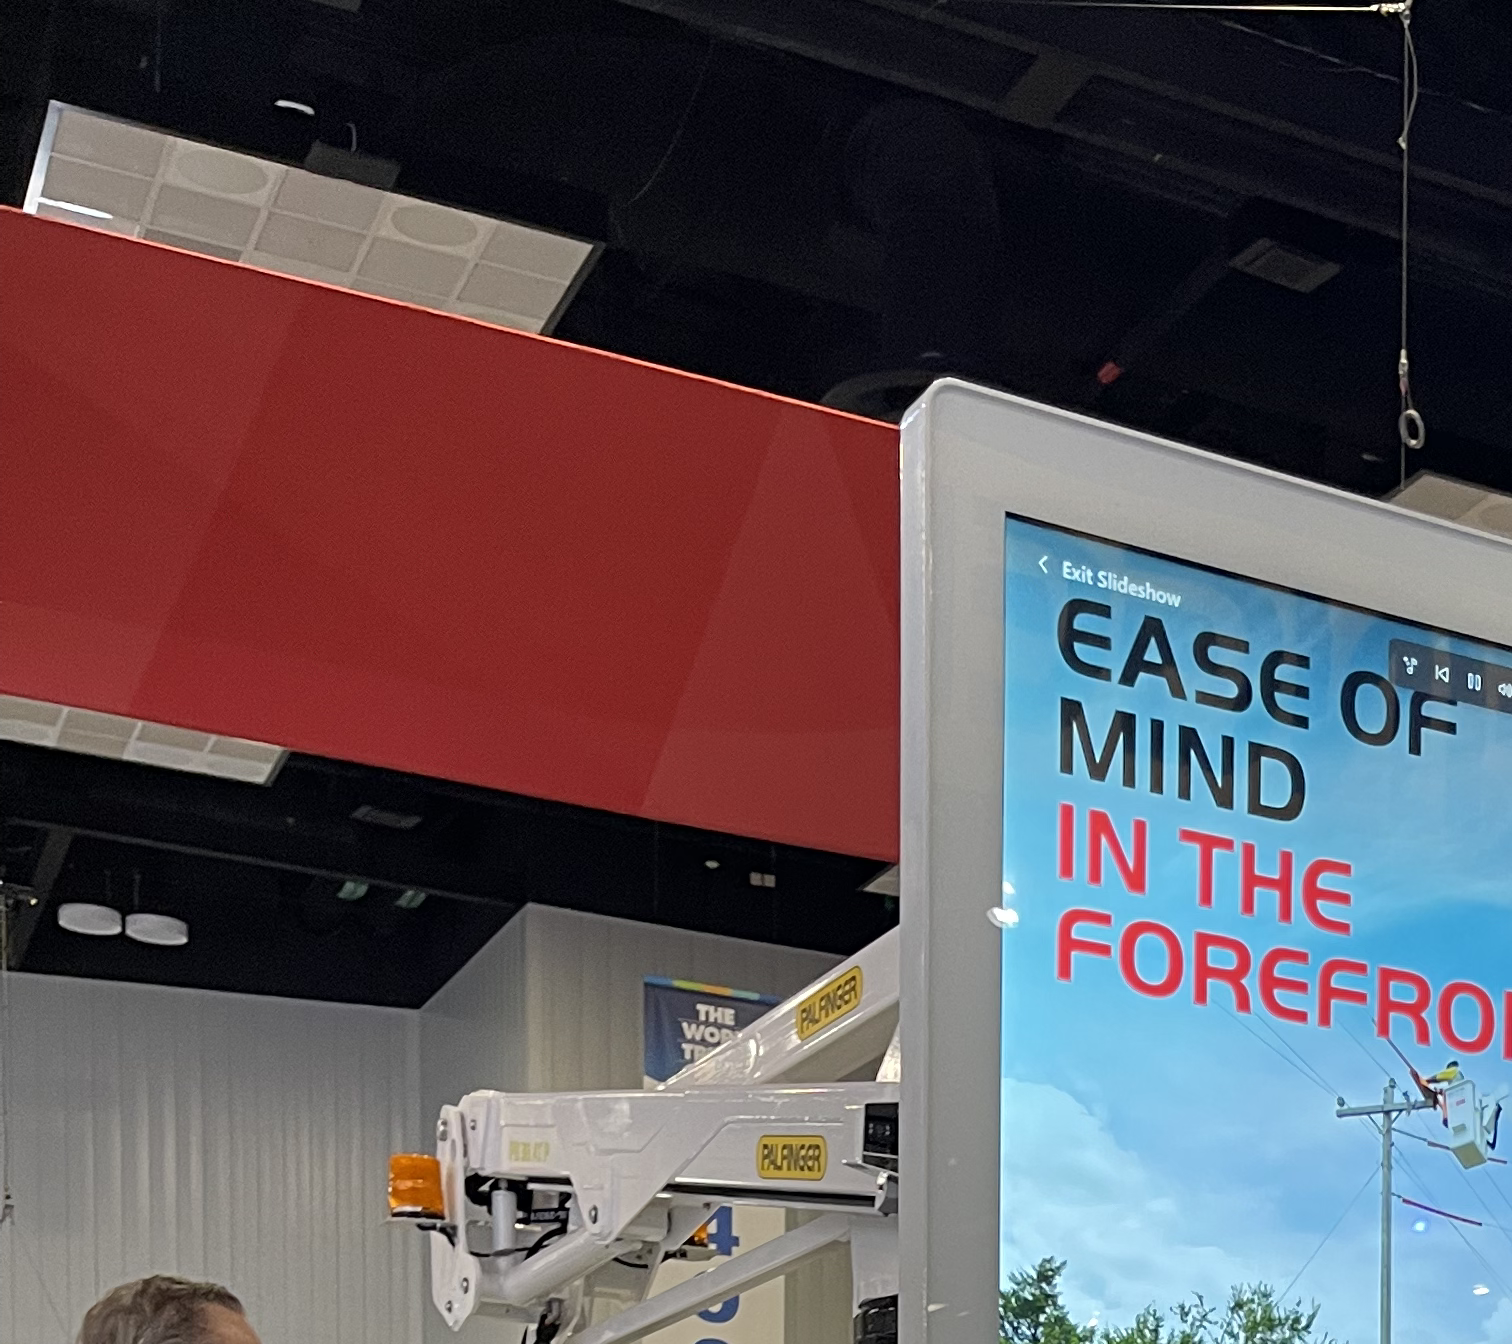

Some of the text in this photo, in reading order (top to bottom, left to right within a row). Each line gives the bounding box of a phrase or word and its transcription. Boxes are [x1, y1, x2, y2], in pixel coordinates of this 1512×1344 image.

[1062, 560, 1182, 608] Exit Slideshow
[1057, 599, 1458, 757] EASE OF
[1059, 697, 1306, 822] MIND
[1058, 803, 1352, 936] IN THE
[696, 1003, 736, 1026] THE
[800, 975, 858, 1034] PALFINGER
[682, 1021, 742, 1045] WOR
[761, 1143, 822, 1173] PALFINGER
